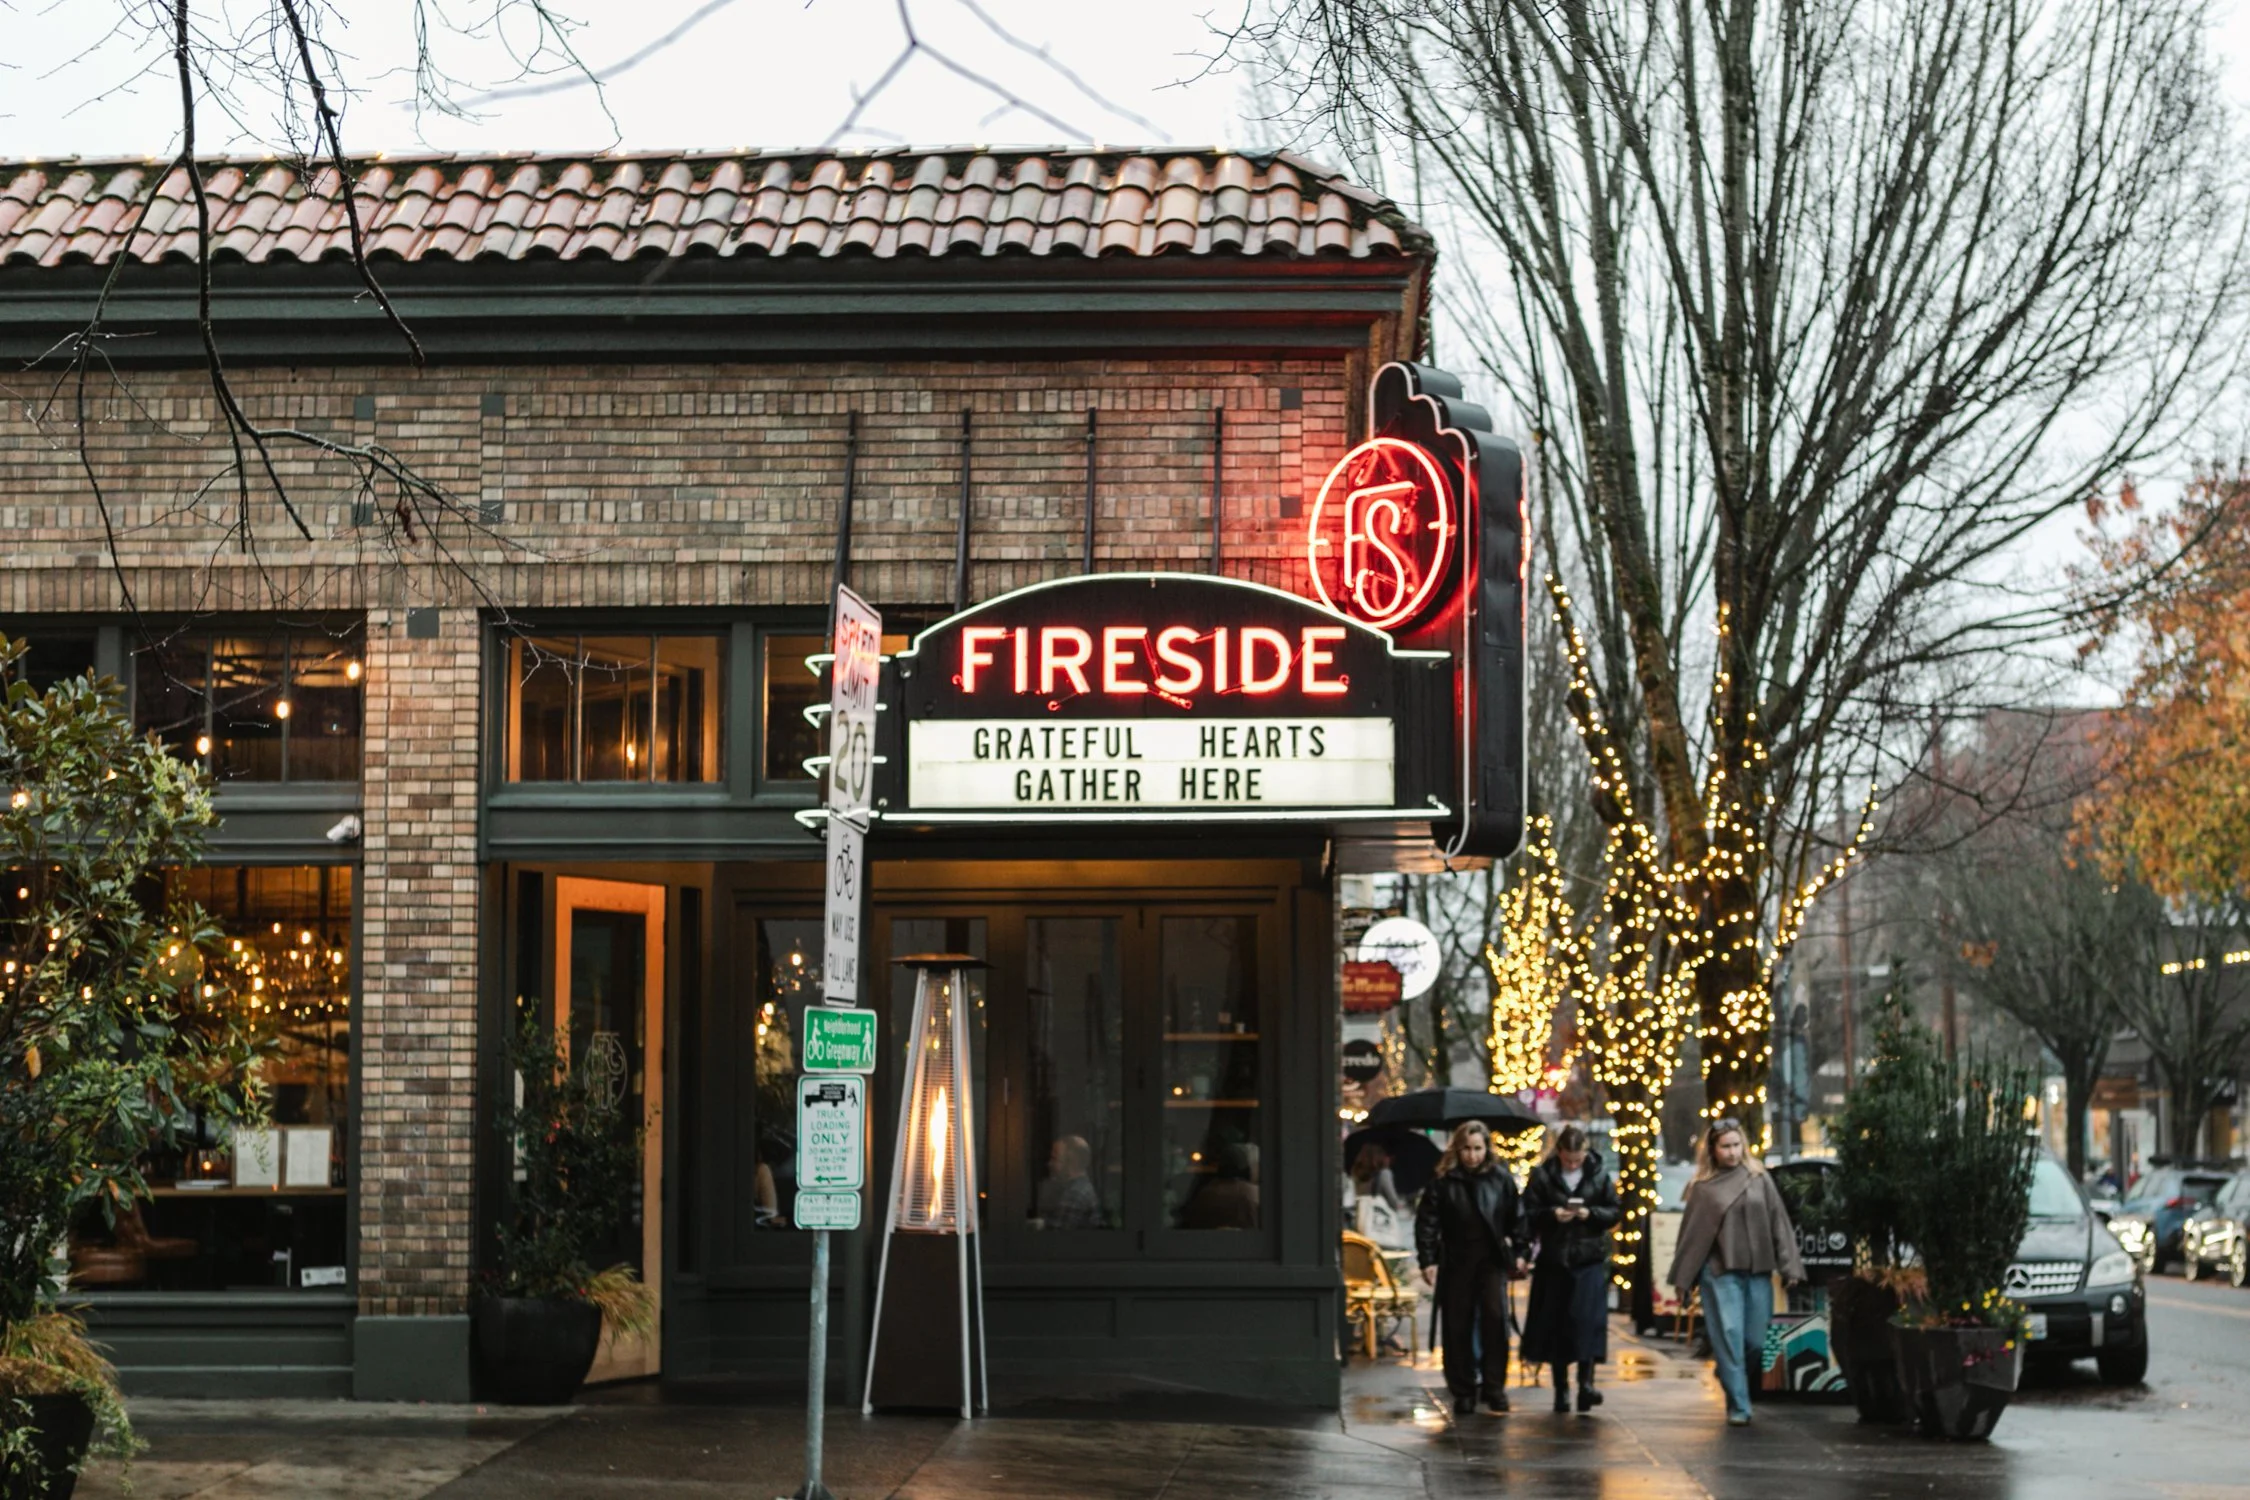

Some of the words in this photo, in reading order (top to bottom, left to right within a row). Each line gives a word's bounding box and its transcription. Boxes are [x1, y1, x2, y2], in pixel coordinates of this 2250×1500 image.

[962, 627, 1347, 693] FIRESIDE
[841, 664, 869, 710] LIMIT
[835, 709, 867, 802] 20
[974, 727, 1143, 759] GRATEFUL
[1200, 725, 1326, 757] HEARTS
[1016, 769, 1142, 801] GATHER
[1181, 767, 1262, 799] HERE
[832, 912, 842, 938] MAY
[844, 915, 854, 942] USE
[829, 951, 840, 981] FULL
[842, 954, 855, 984] LANE
[826, 1040, 861, 1066] Greenway
[811, 1121, 850, 1131] LOADING
[817, 1109, 846, 1119] TRUCK
[812, 1132, 849, 1145] ONLY
